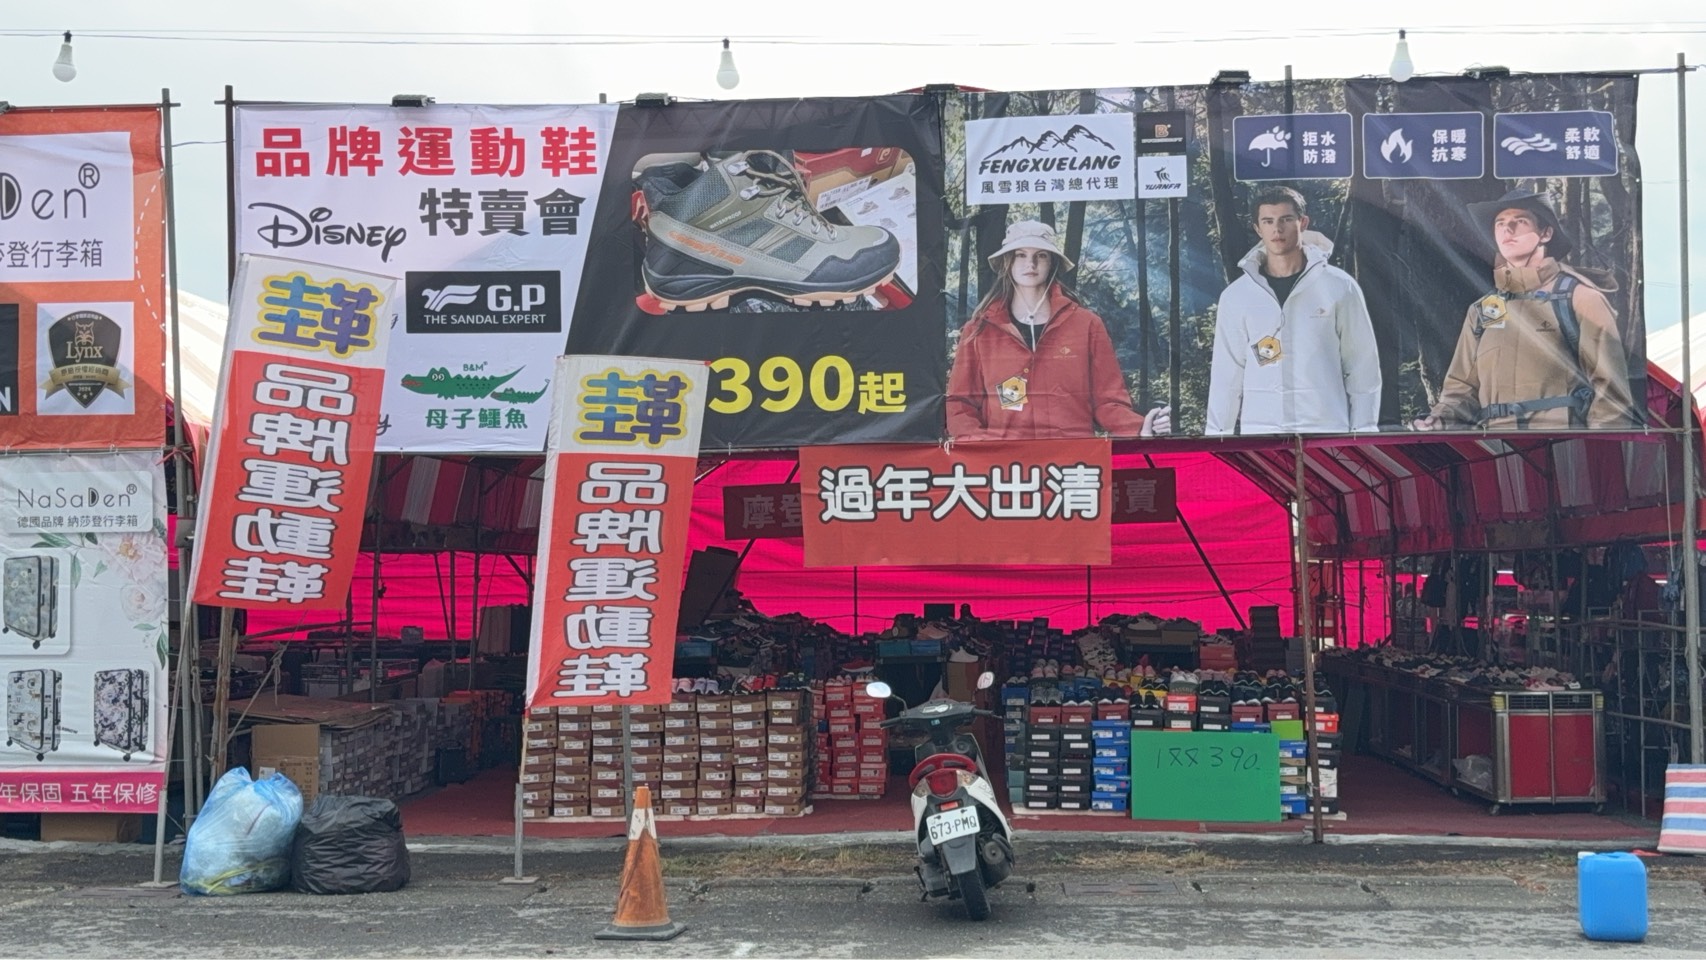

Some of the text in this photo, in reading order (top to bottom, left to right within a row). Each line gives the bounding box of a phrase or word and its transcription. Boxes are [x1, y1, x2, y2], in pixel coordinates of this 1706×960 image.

[1302, 131, 1336, 146] 拒水
[1432, 128, 1466, 144] 保暖
[1565, 127, 1600, 143] 柔軟
[256, 126, 597, 178] 品牌運動鞋
[1303, 149, 1336, 164] 防潑
[1432, 147, 1466, 162] 抗寒
[1565, 145, 1600, 160] 舒適
[979, 155, 1122, 176] FENGXUELANG
[981, 177, 1119, 194] 風雪狼台灣總代理
[420, 188, 587, 236] 特賣會
[0, 239, 104, 269] 登行李箱
[487, 284, 546, 312] G.P
[424, 313, 546, 325] THE SANDAL EXPERT
[66, 341, 103, 363] Lynx
[425, 408, 528, 430] 母子鱷魚
[818, 464, 1102, 524] 過年大出清
[17, 515, 138, 529] 德國品牌 納莎登行李箱
[0, 782, 158, 804] 年保固 五年保修
